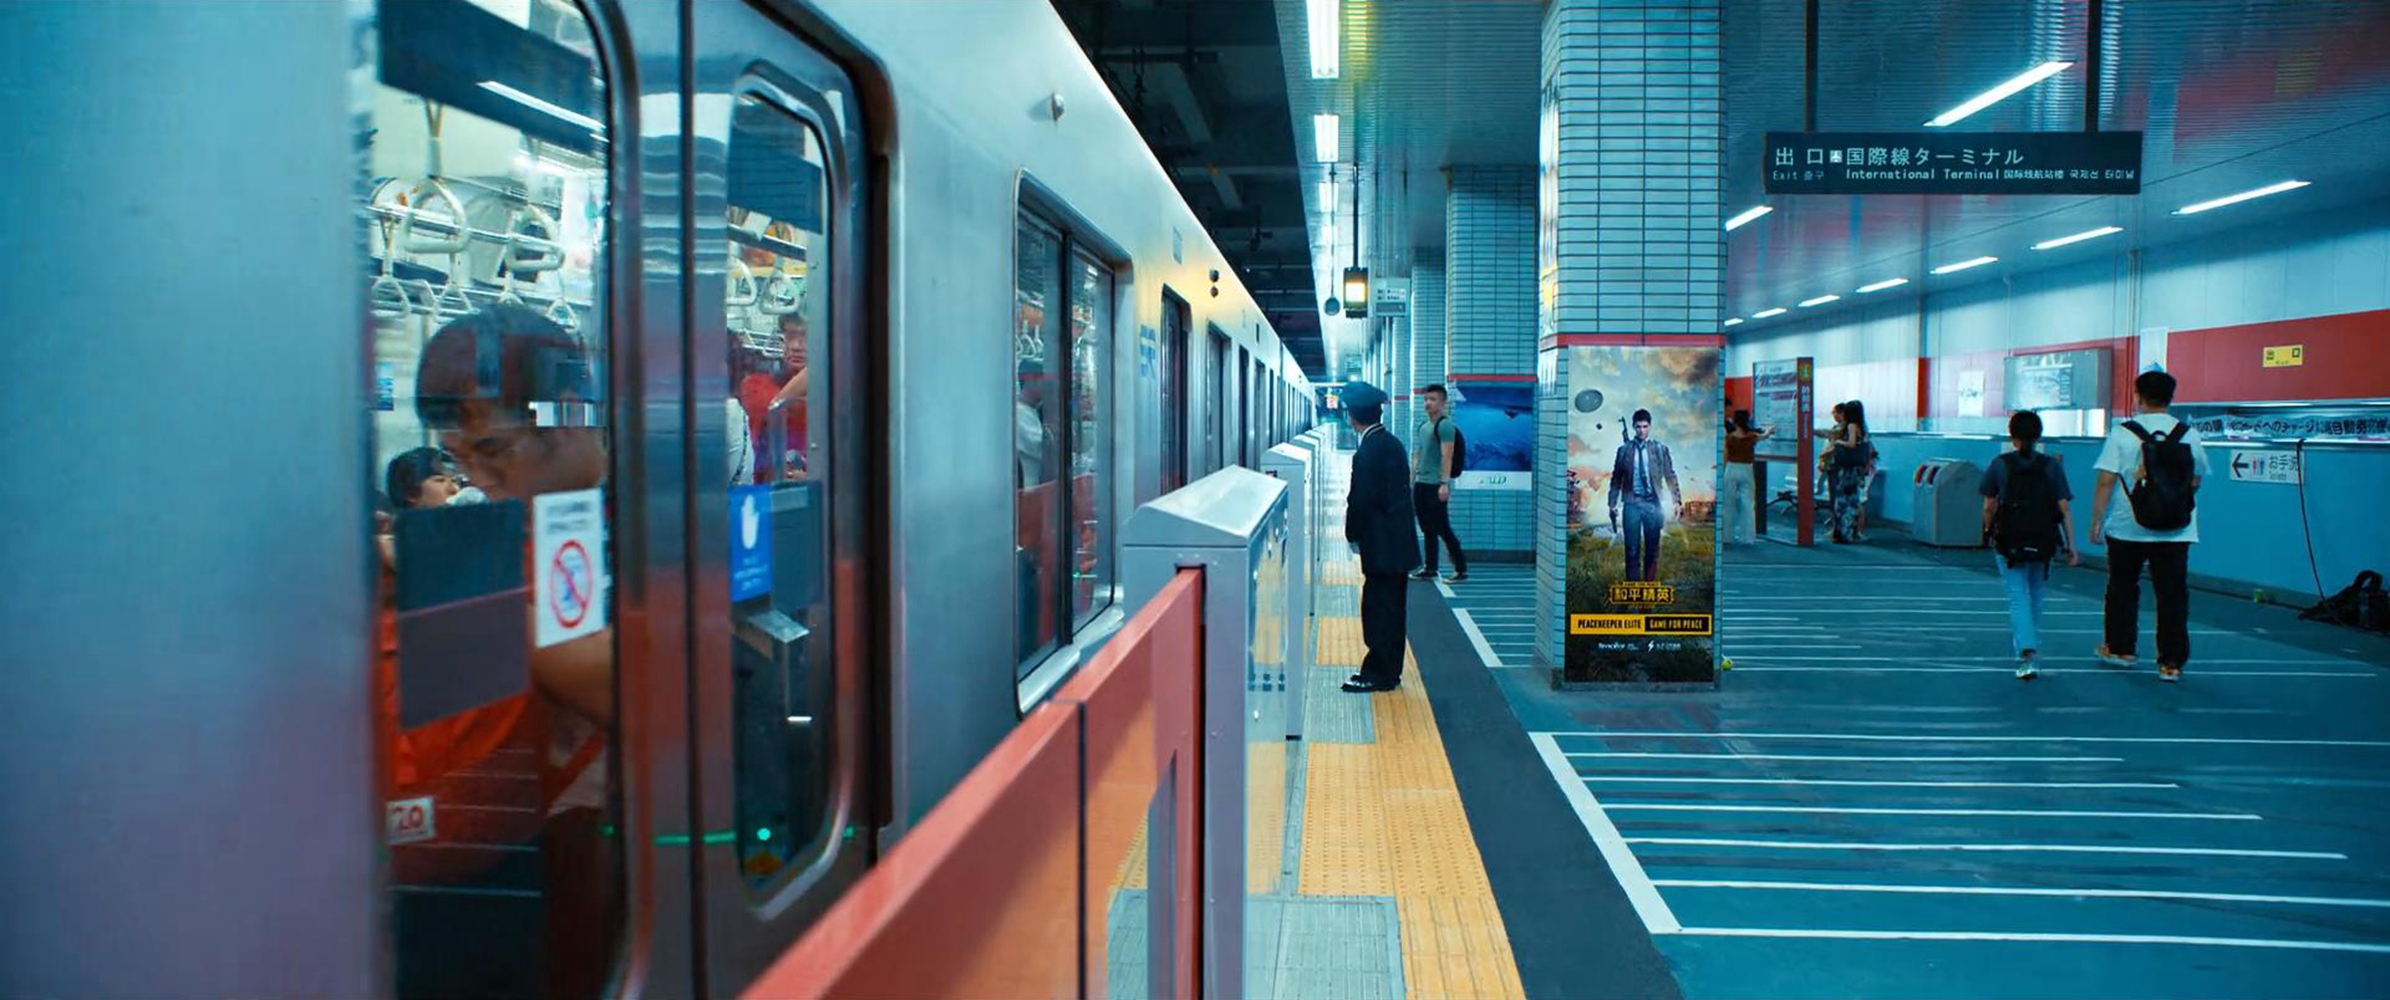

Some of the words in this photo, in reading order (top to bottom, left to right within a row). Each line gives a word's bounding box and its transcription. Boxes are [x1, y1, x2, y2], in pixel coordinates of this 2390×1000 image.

[1776, 147, 1823, 165] 出口
[1846, 147, 2024, 166] 国際線ターミナル
[1773, 170, 1798, 181] Exit
[1846, 169, 1935, 180] International
[1944, 169, 1999, 180] Terminal
